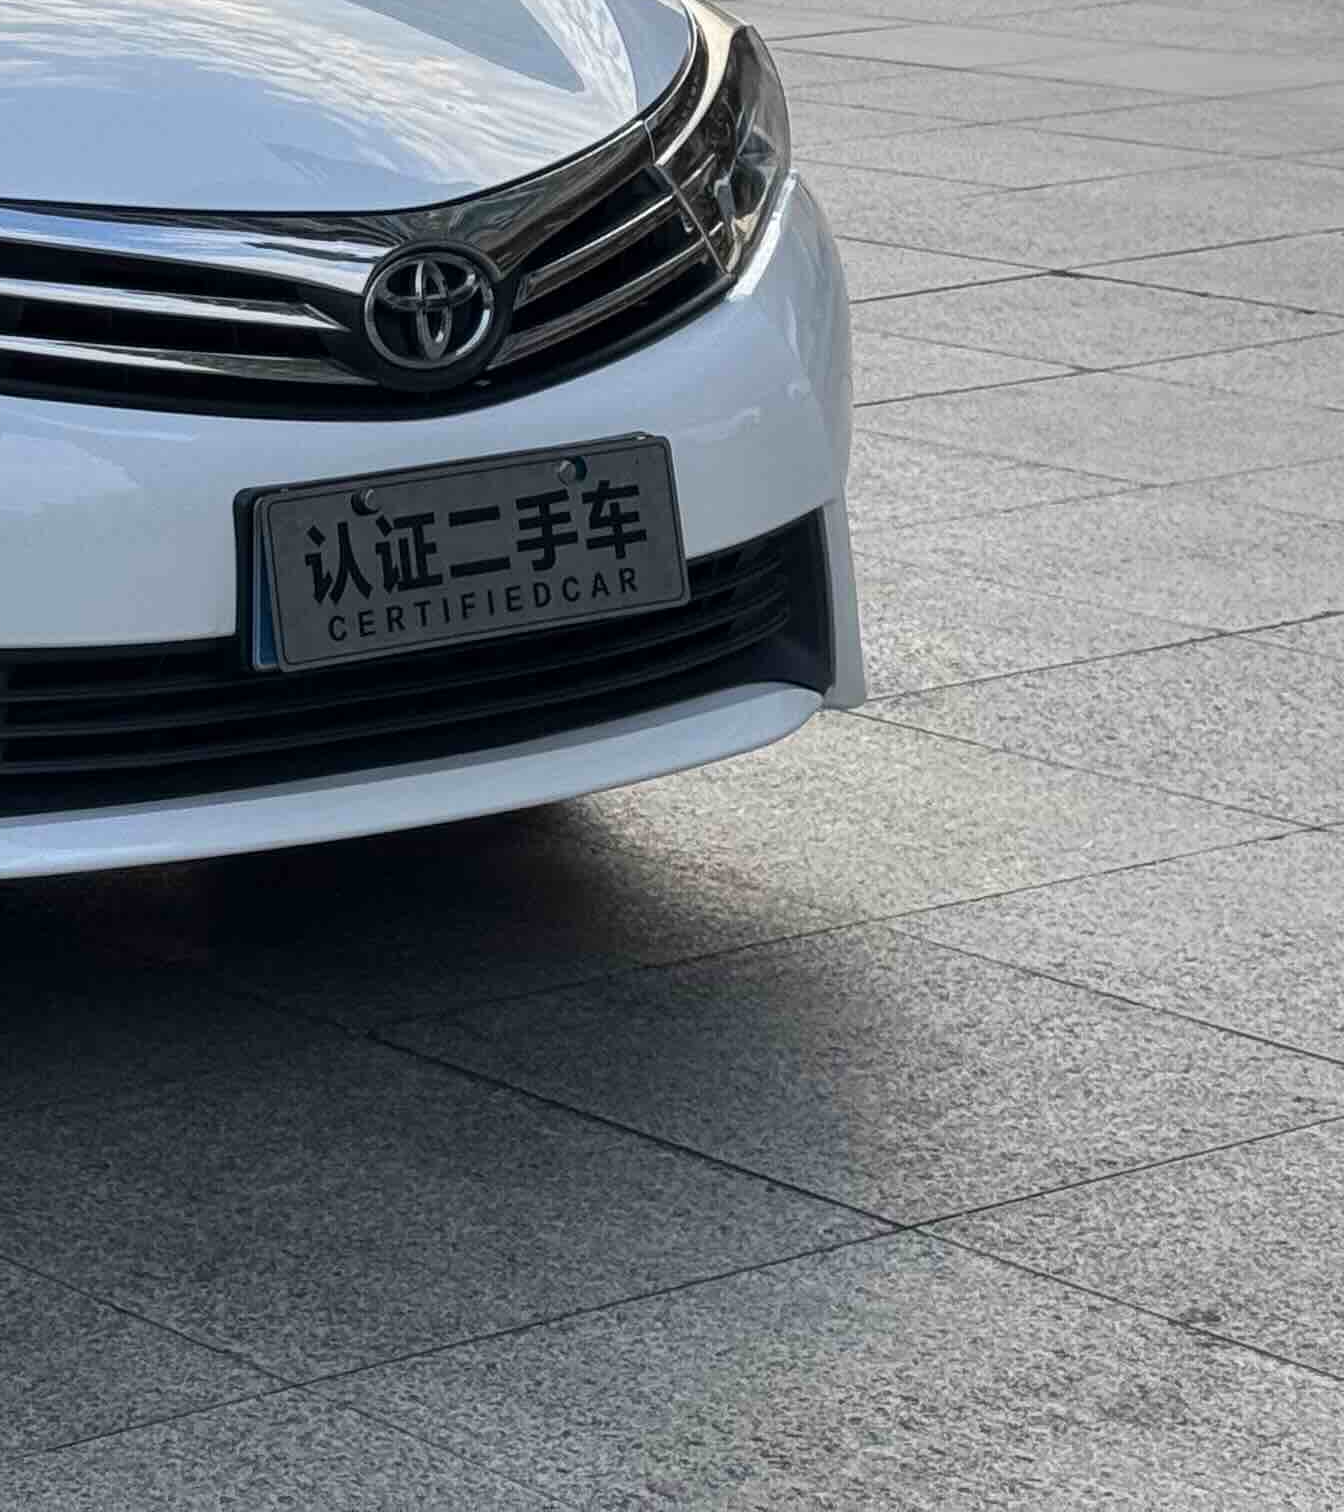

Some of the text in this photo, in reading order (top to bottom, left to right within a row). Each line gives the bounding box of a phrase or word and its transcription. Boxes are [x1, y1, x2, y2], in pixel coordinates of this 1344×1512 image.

[304, 479, 648, 606] 认证二手车
[328, 567, 639, 642] CERTIFIEDCAR
